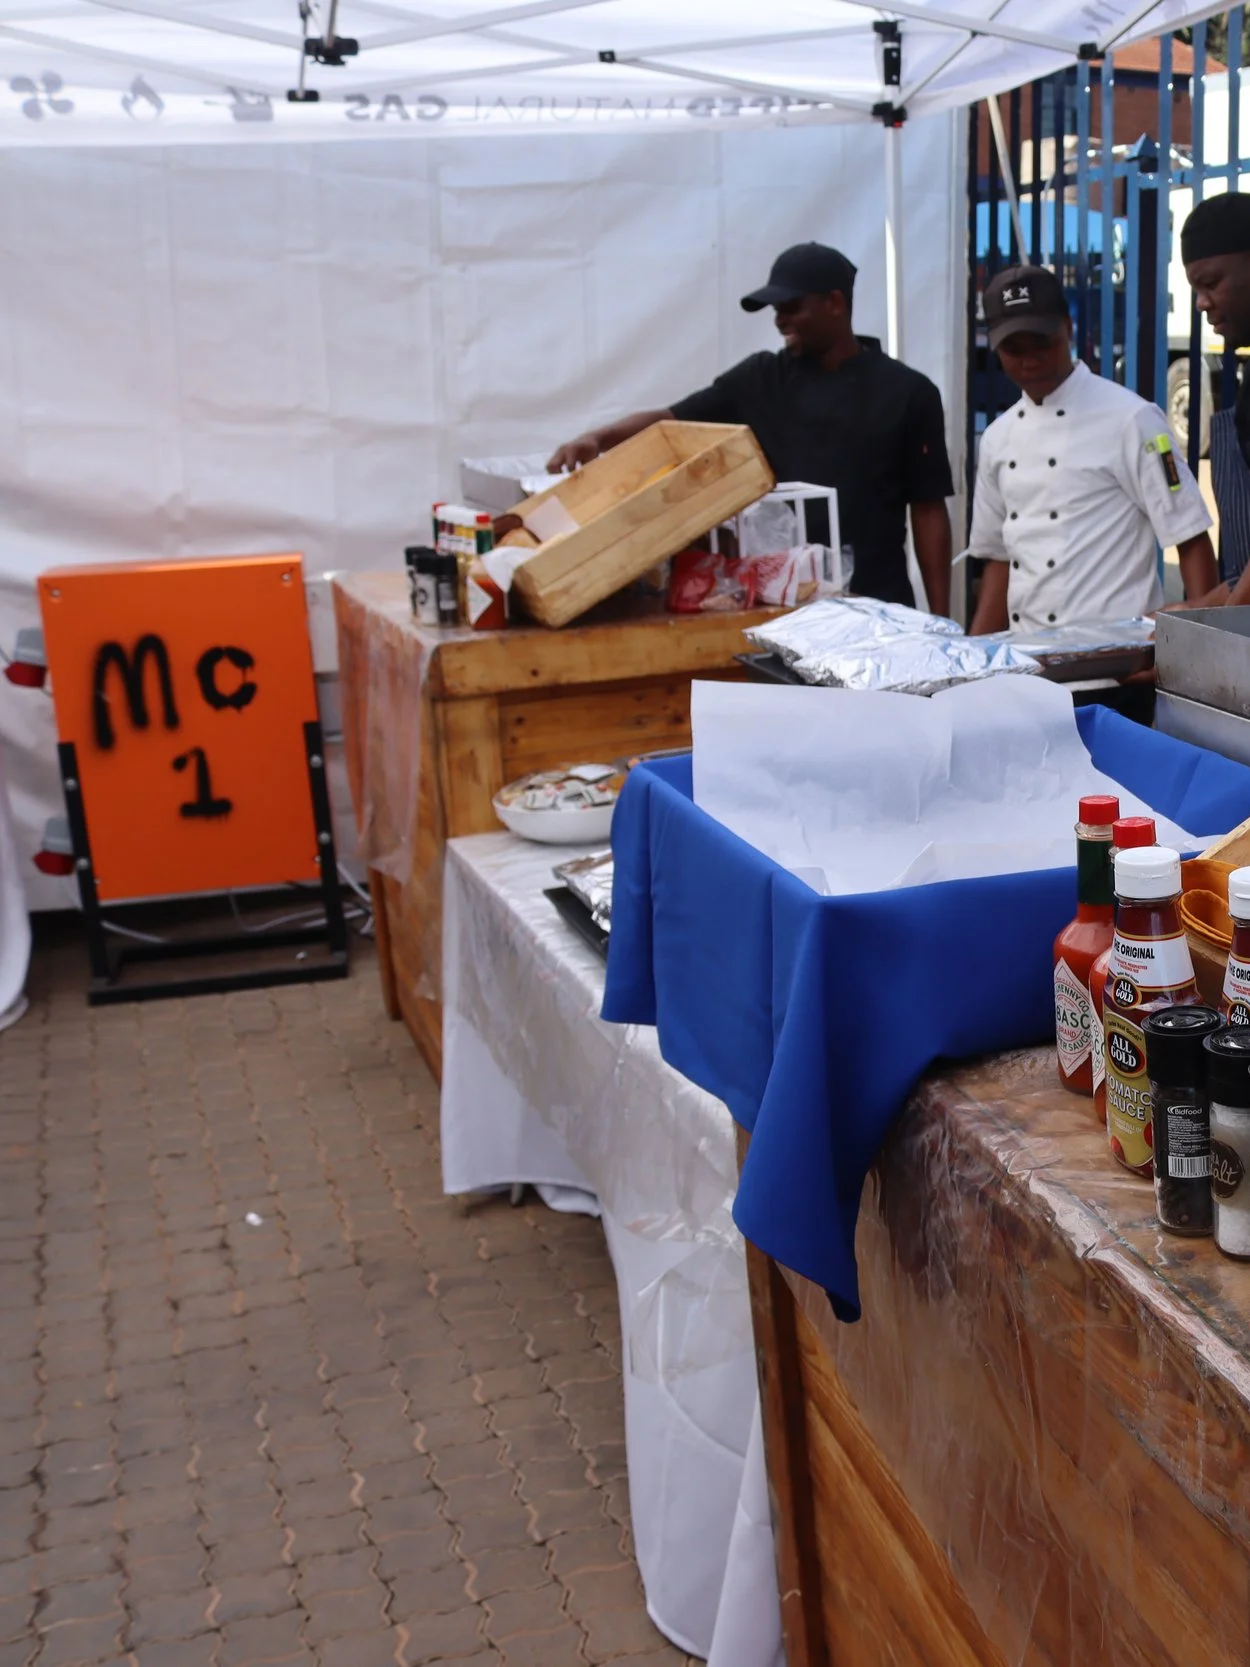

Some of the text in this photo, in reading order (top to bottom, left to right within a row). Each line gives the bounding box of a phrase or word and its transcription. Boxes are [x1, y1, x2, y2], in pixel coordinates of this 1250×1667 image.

[172, 747, 232, 821] 1
[1120, 944, 1155, 959] ORIGINAL
[1119, 980, 1132, 993] ALL
[1115, 989, 1134, 1003] GOLD
[1234, 1005, 1247, 1017] ALL
[1068, 1031, 1091, 1052] SAUCE
[1112, 1034, 1132, 1054] ALL
[1110, 1045, 1137, 1068] GOLD
[1108, 1090, 1146, 1121] SAUCE
[1174, 1107, 1203, 1115] Bidfood
